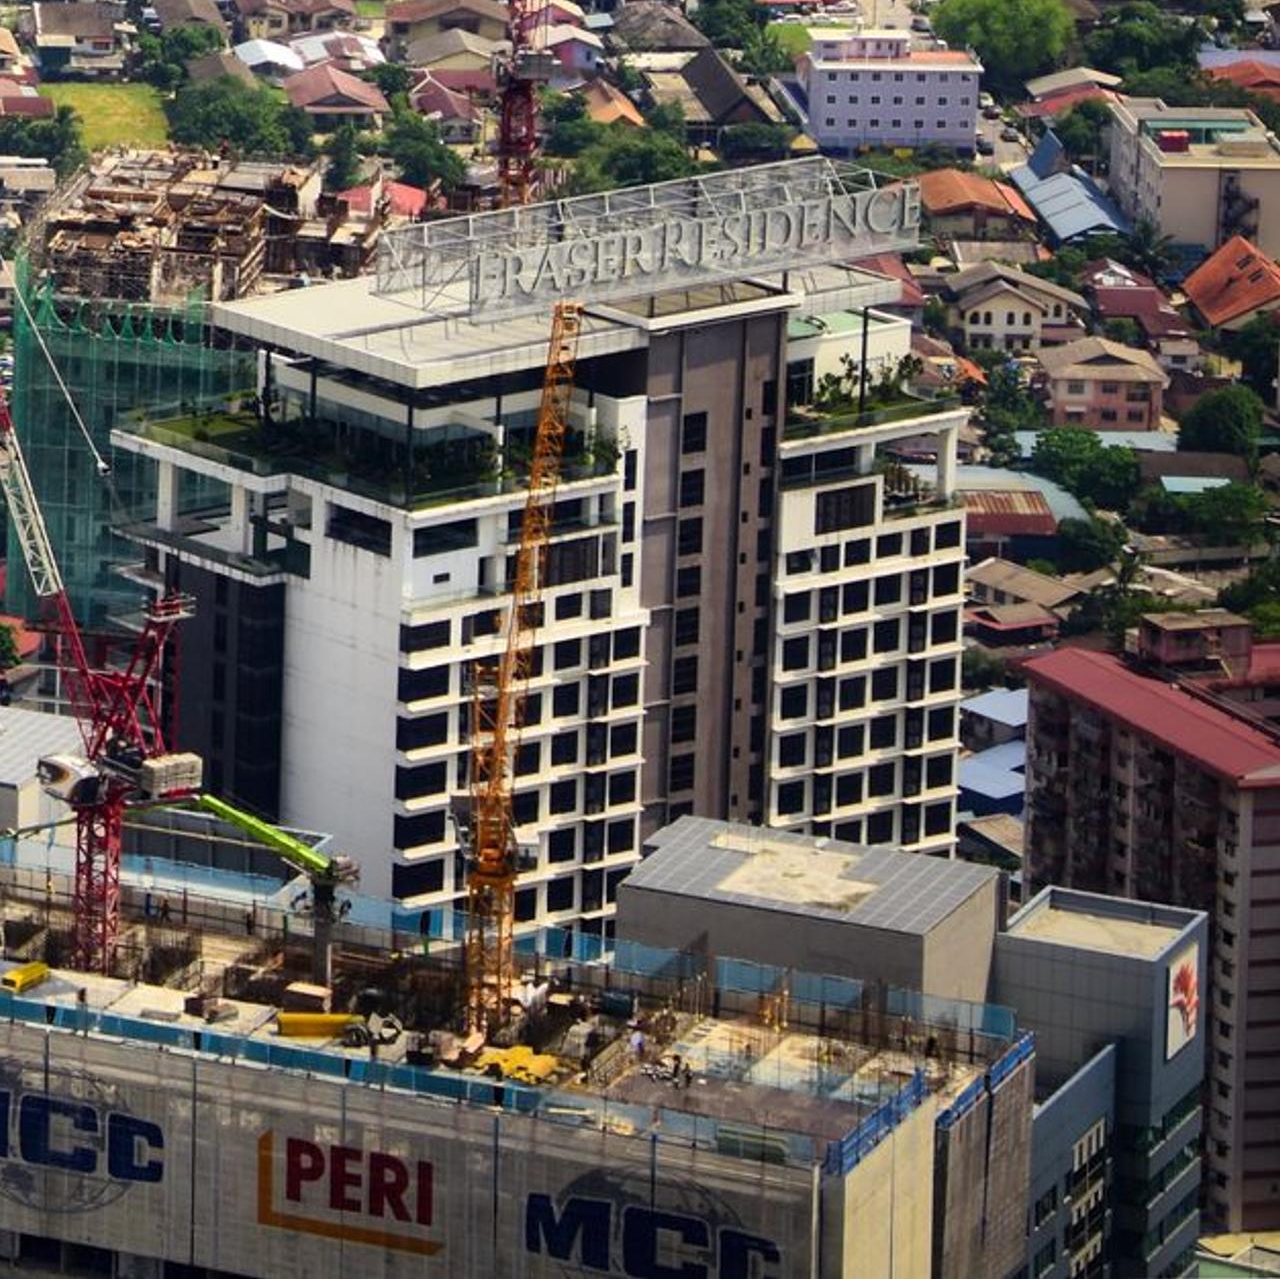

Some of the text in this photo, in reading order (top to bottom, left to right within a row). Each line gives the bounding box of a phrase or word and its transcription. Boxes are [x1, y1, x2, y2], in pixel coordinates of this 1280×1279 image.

[474, 181, 922, 301] FRASER RESIDENCE
[286, 1137, 434, 1227] PERI
